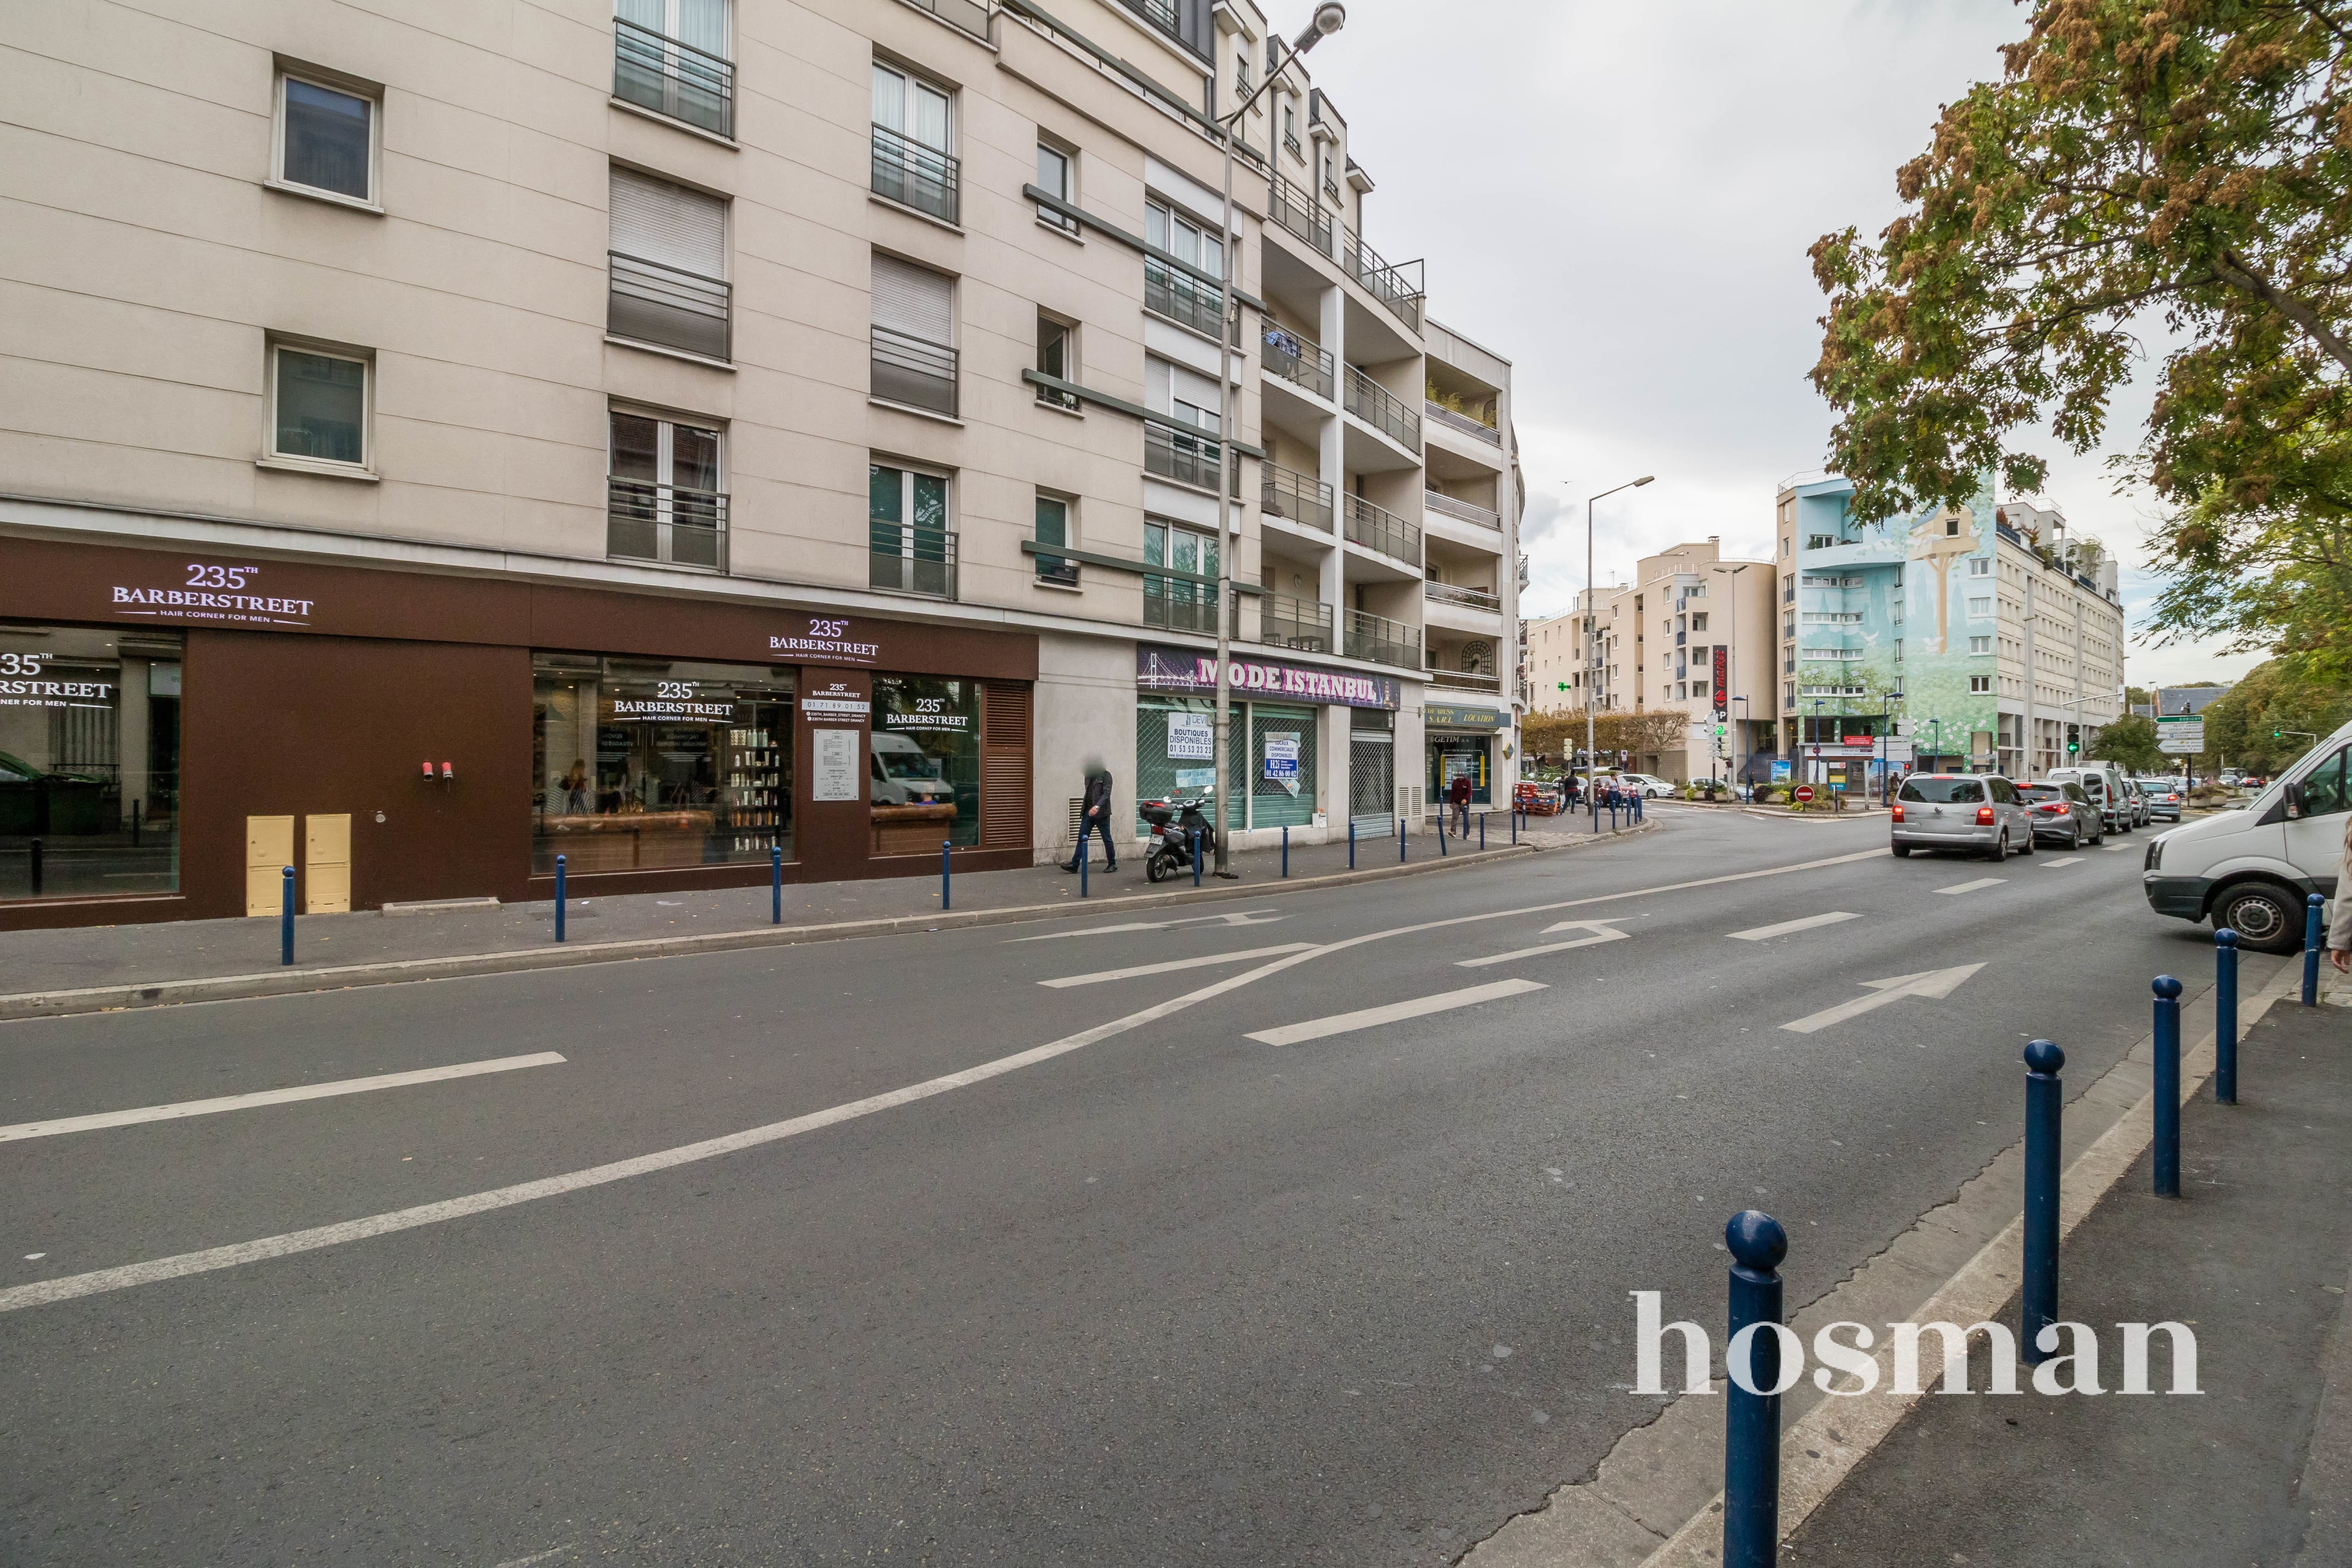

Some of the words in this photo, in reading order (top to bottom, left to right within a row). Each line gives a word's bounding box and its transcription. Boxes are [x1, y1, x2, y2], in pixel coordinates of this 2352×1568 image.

[112, 586, 314, 615] BARBERSTREET
[186, 611, 225, 620] CORNER
[769, 636, 879, 656] BARBERSTREET
[1714, 650, 1725, 687] market
[1197, 658, 1281, 690] MODE
[1282, 668, 1377, 701] ISTANBUL
[614, 701, 733, 715] BARBERSTREET
[886, 714, 968, 726] BARBERSTREET
[1463, 714, 1496, 722] LOCATION
[1174, 728, 1208, 737] BOUTIQUES
[1169, 736, 1211, 745] DISPONIBLES
